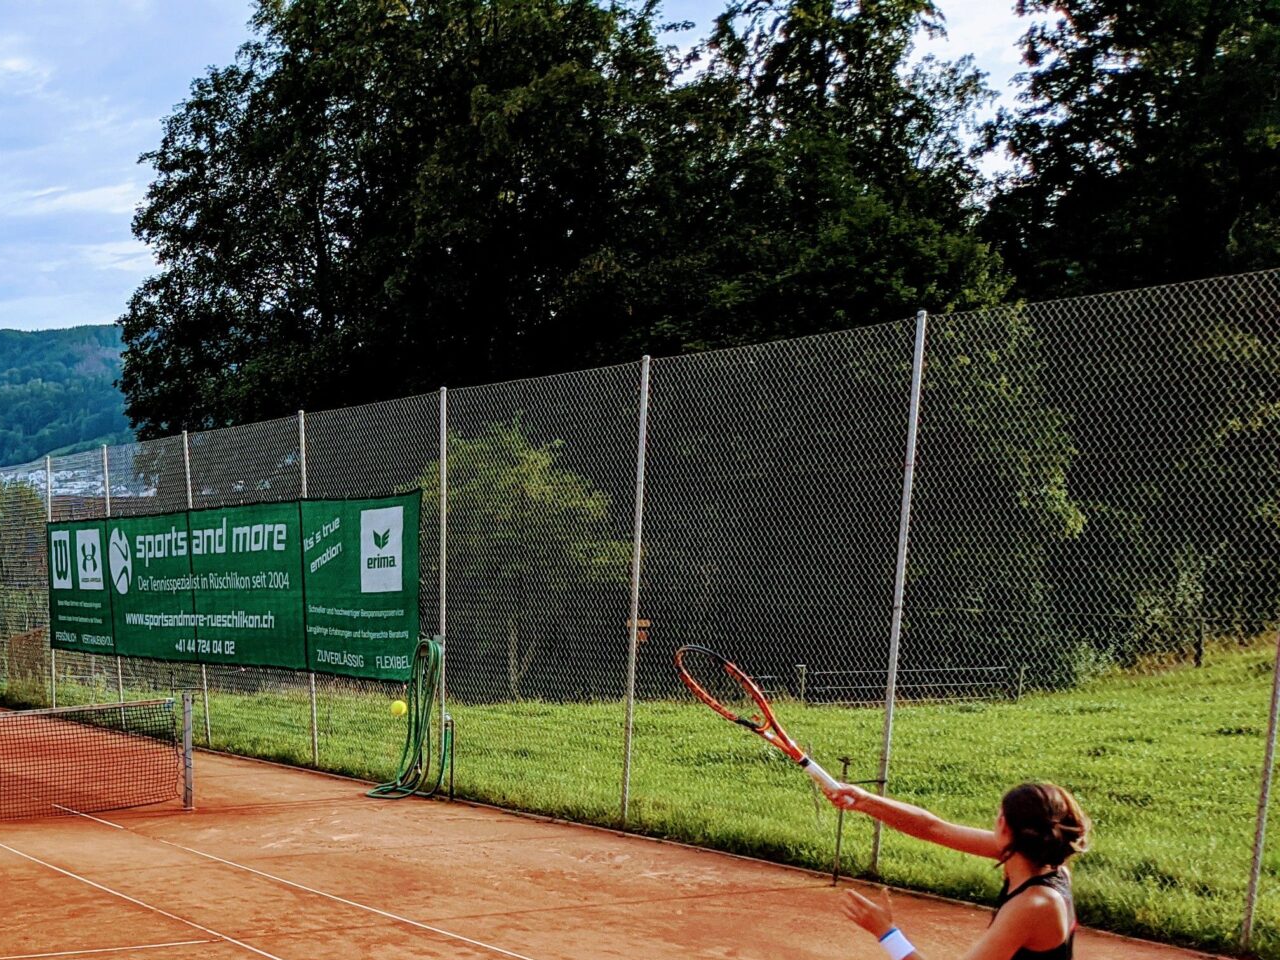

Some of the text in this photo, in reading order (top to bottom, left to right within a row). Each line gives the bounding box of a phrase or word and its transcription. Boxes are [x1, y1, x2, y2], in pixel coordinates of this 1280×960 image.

[322, 517, 340, 538] true
[136, 517, 287, 567] sports and more
[310, 542, 342, 574] emotion
[138, 571, 289, 594] Der Tennisspezialist in Rüschlikon seit 2004
[126, 610, 275, 630] www.sportsandmore-rueschlikon.ch
[175, 638, 235, 655] +41 44 724 04 02
[317, 649, 365, 668] ZUVERLÄSSIG
[375, 655, 412, 669] FLEXIBEL
